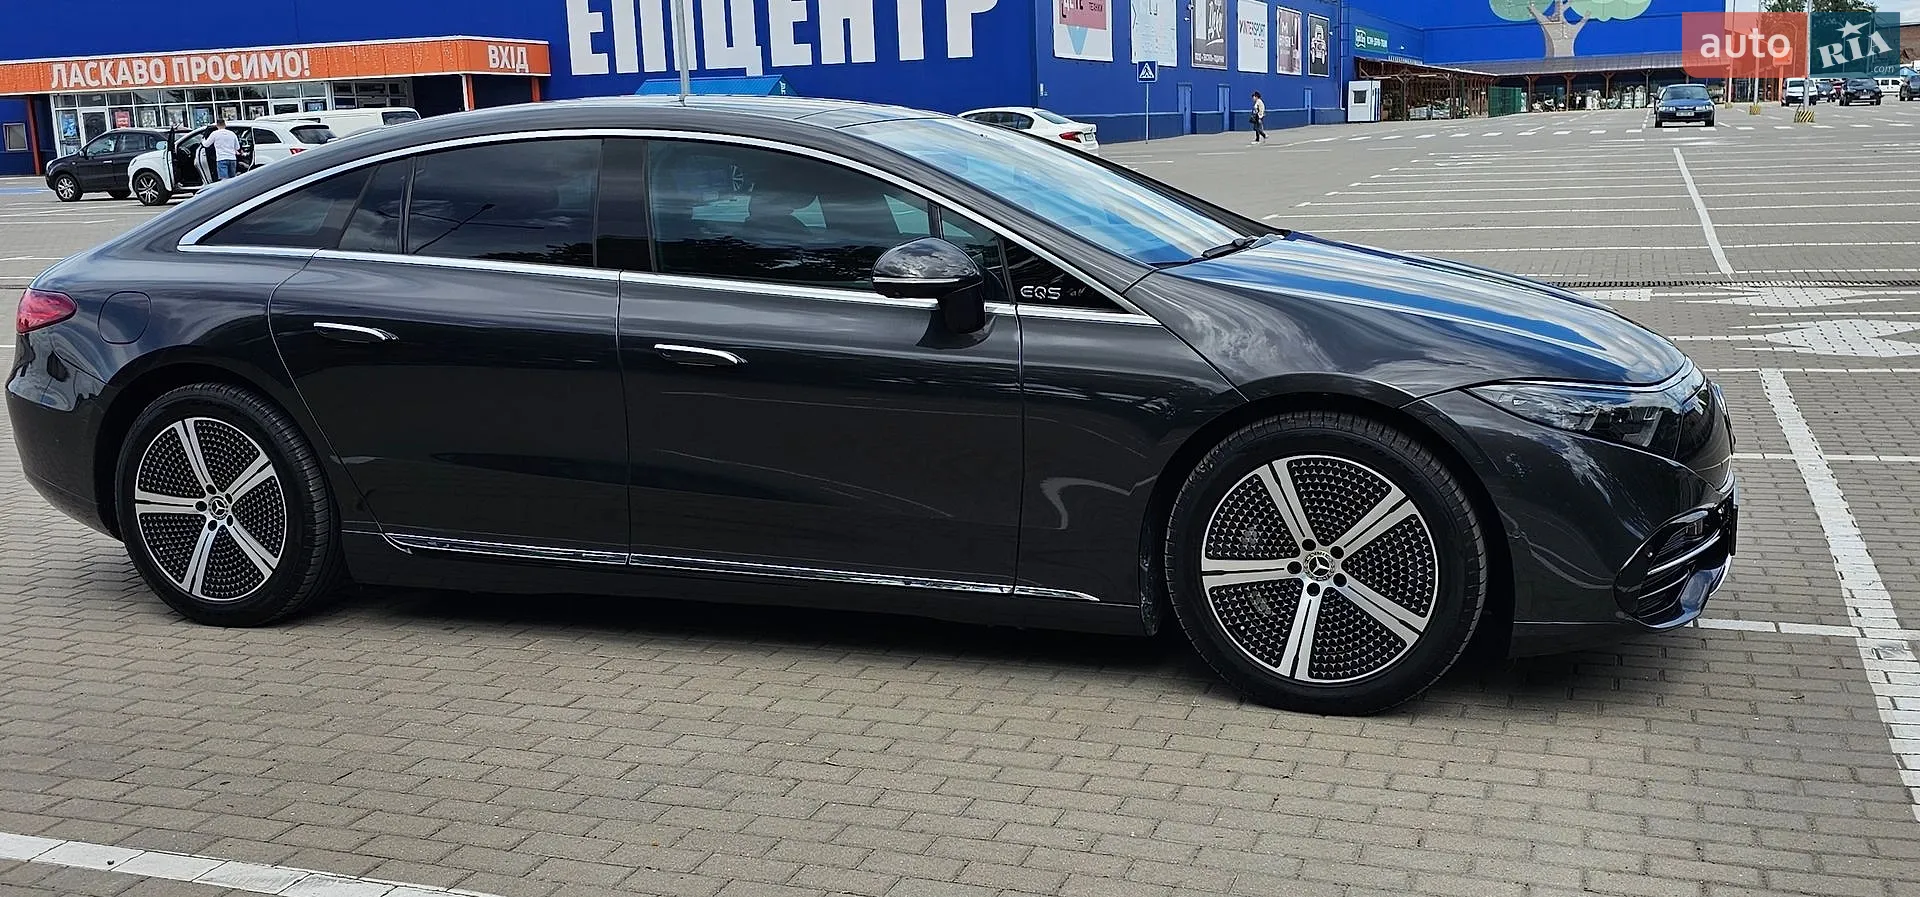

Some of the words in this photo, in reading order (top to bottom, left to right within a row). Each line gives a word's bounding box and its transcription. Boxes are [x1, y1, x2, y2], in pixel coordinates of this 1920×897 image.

[51, 58, 166, 89] ЛАСКАВО
[172, 50, 311, 83] ПРОСИМО!
[487, 44, 530, 73] ВХІД
[1020, 285, 1062, 300] EQS
